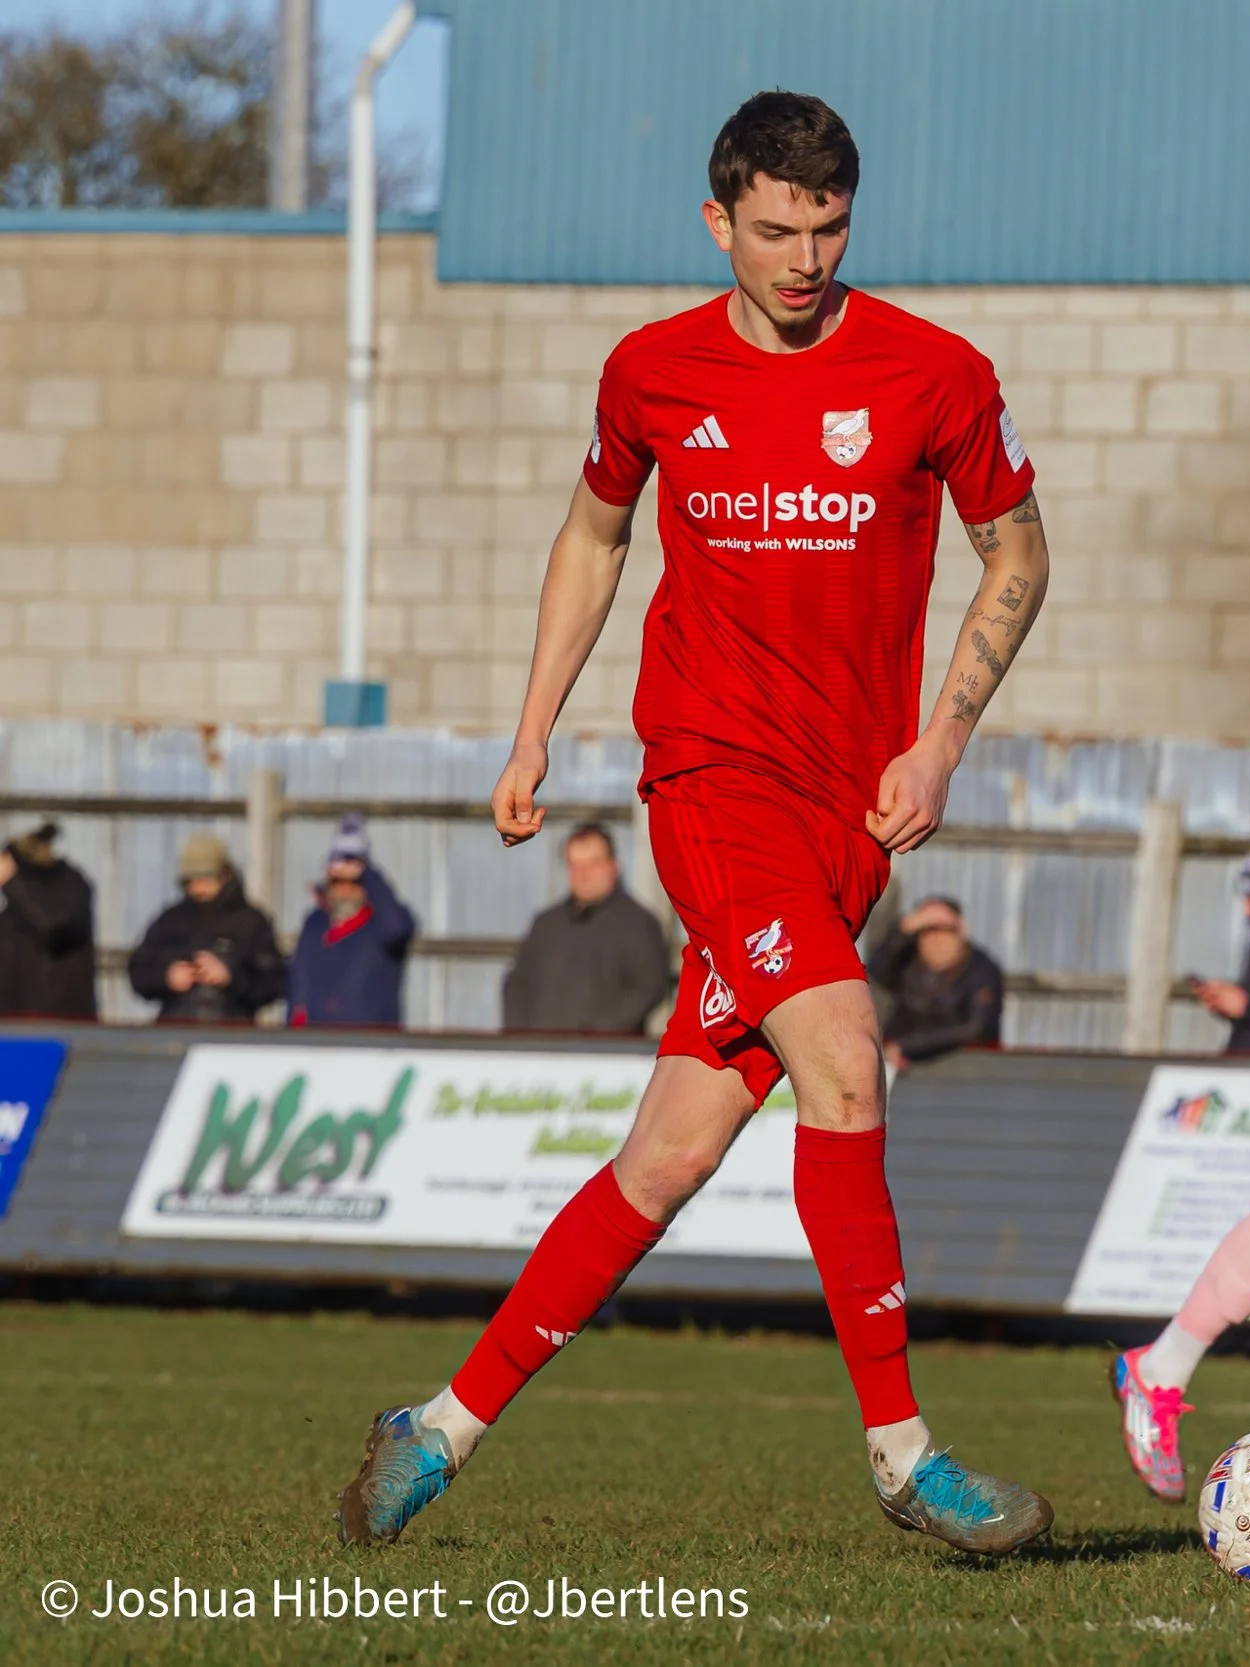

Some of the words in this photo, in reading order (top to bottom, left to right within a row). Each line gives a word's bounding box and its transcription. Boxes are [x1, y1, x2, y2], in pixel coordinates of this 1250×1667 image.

[707, 537, 752, 553] working
[754, 538, 782, 551] with
[786, 538, 856, 551] WILSONS
[180, 1064, 416, 1196] West
